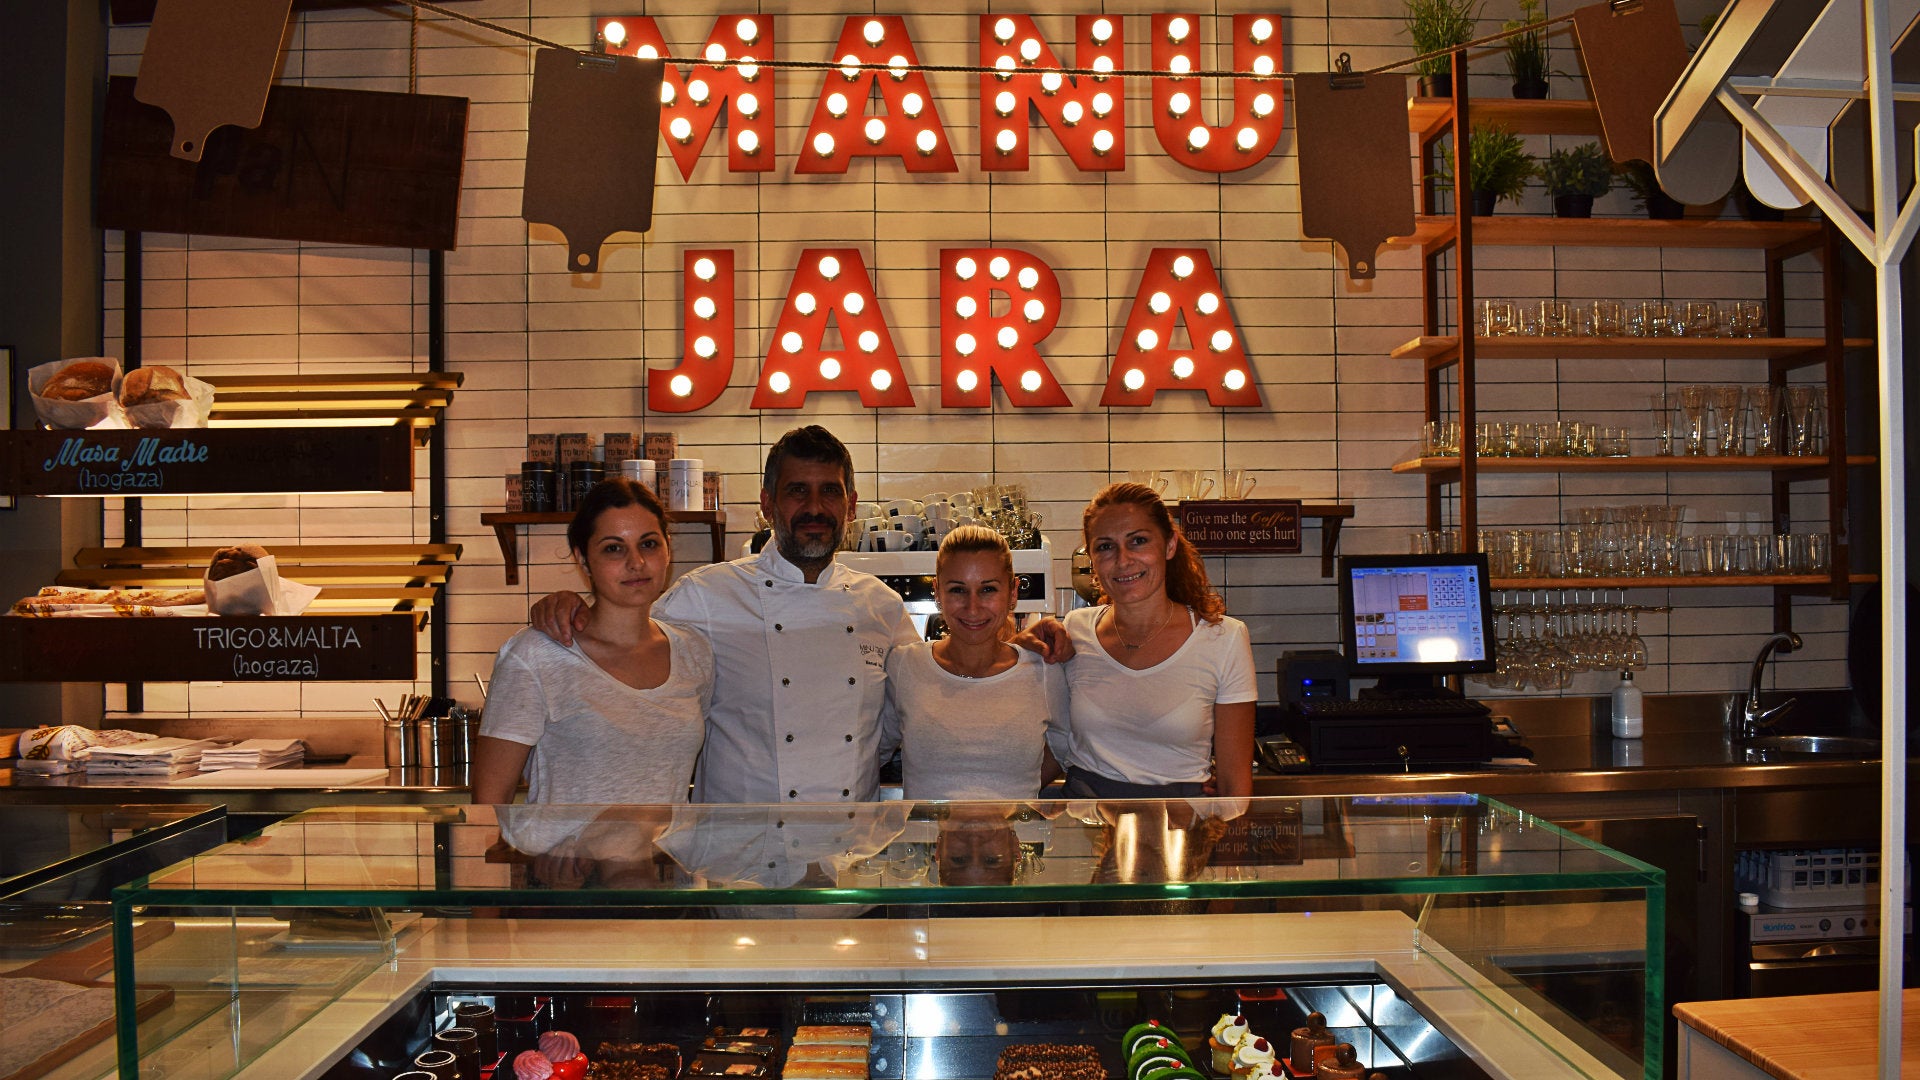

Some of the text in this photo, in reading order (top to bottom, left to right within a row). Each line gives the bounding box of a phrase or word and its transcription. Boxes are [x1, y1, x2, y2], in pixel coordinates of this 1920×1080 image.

[597, 14, 1284, 182] MANU
[648, 248, 1263, 412] JARA
[44, 437, 208, 472] Masa Madre
[79, 467, 164, 491] (hogaza)
[1186, 511, 1294, 528] Give me the Coffee
[1187, 527, 1296, 543] and no one gets hurt
[193, 626, 362, 650] TRIGO&MALTA
[232, 653, 319, 679] (hogaza)
